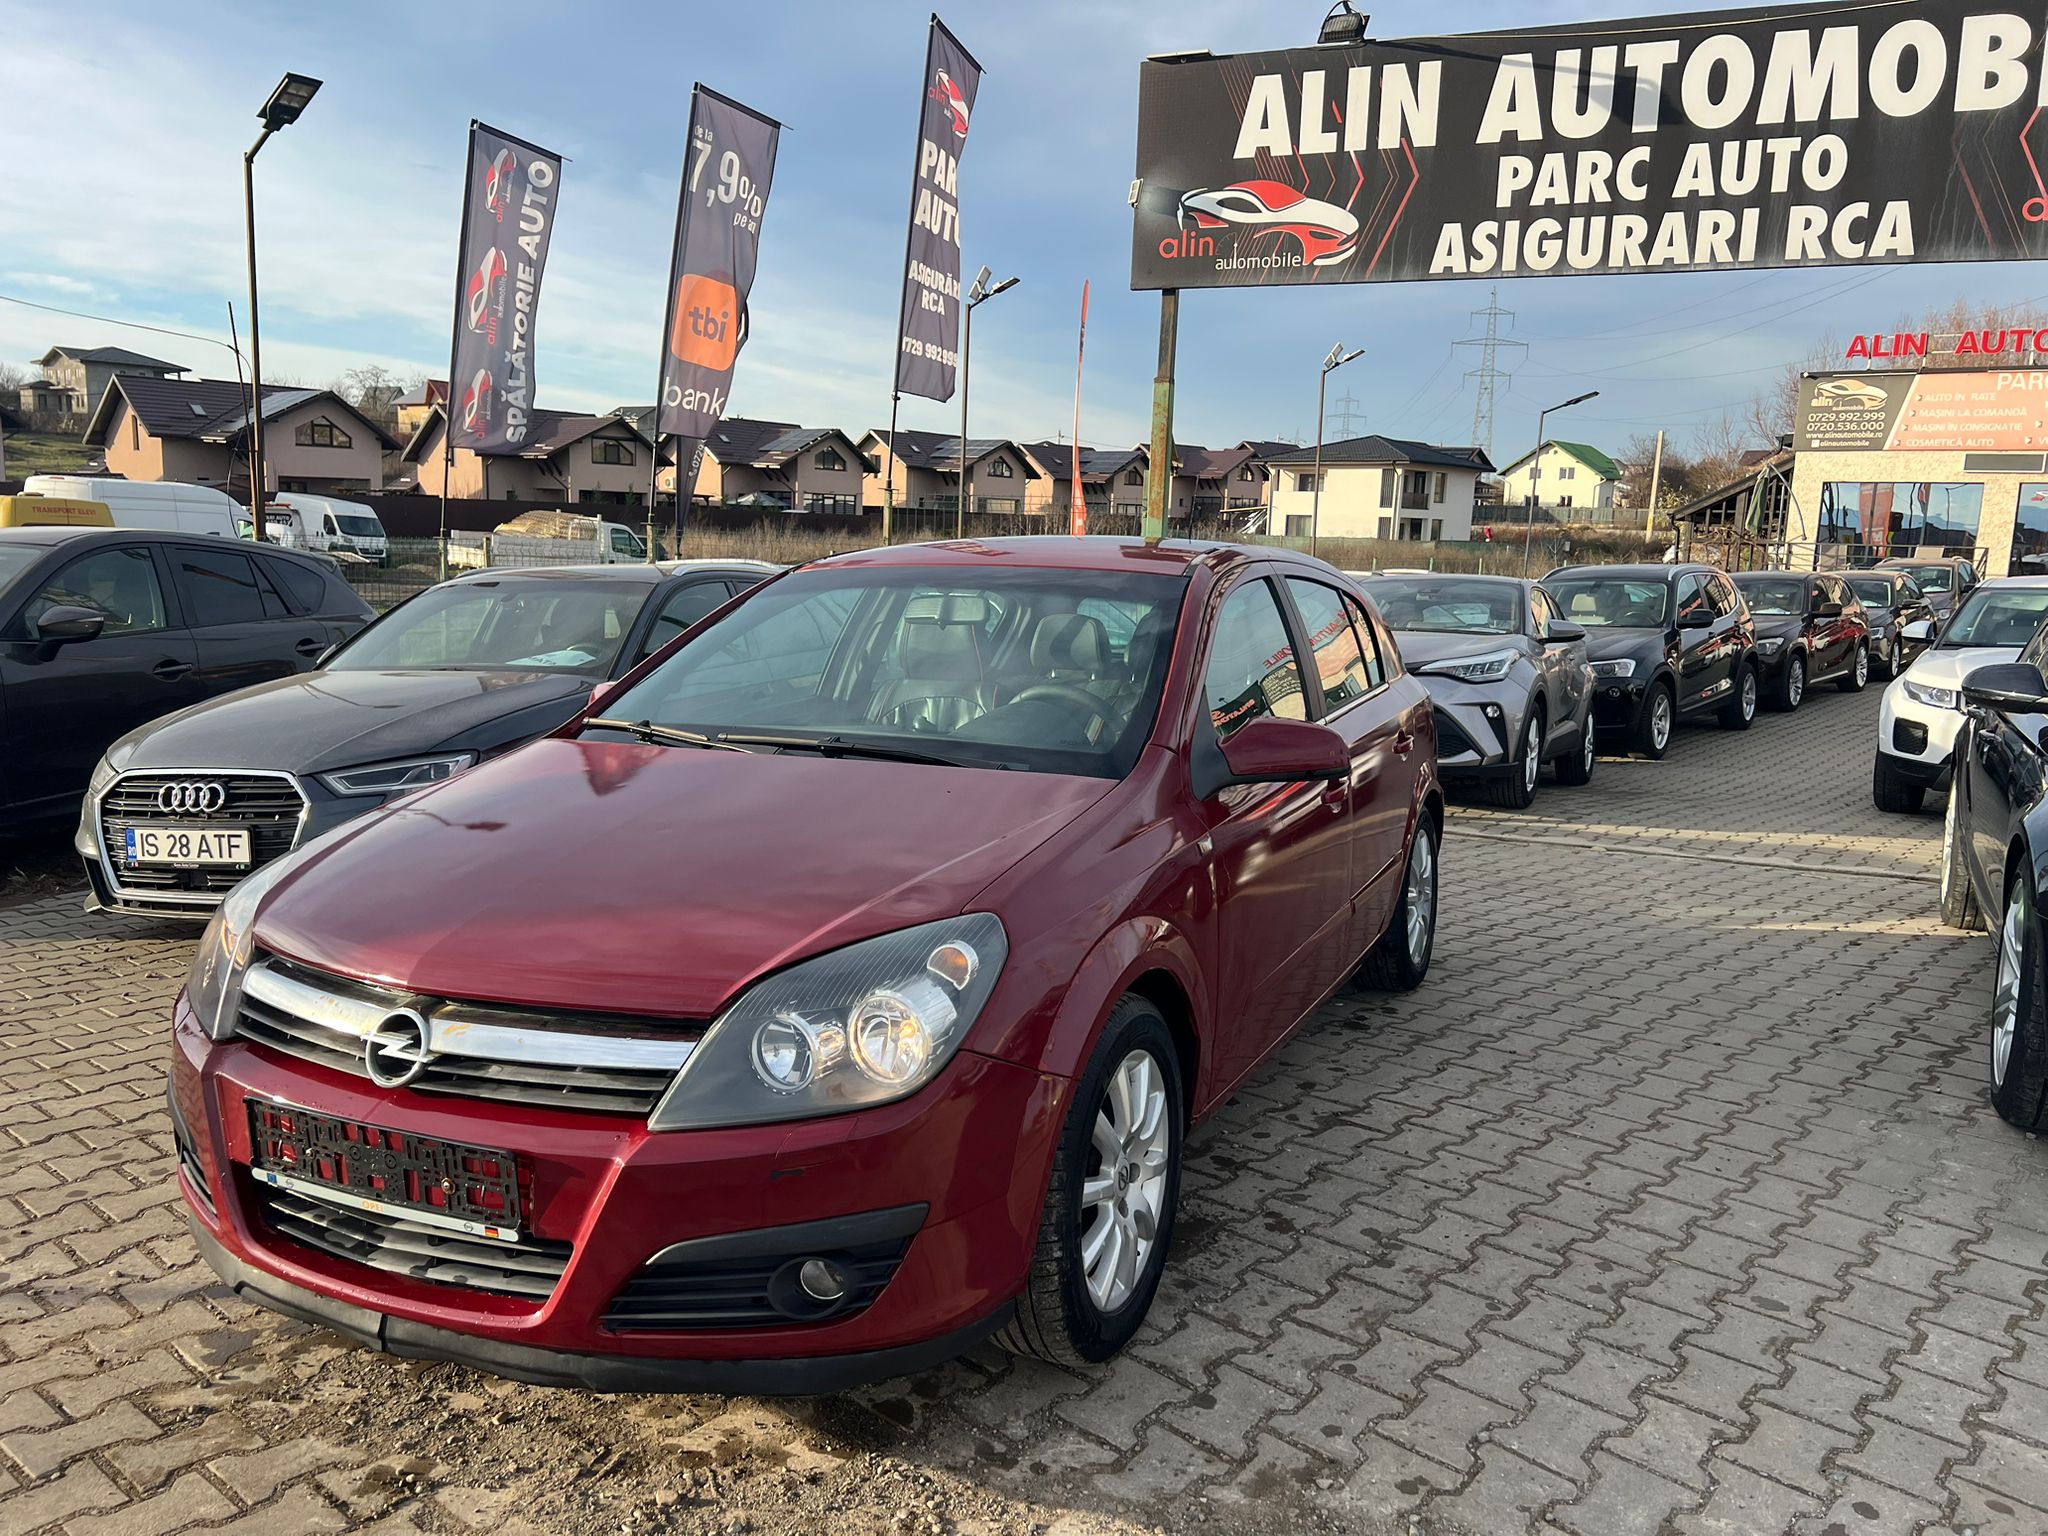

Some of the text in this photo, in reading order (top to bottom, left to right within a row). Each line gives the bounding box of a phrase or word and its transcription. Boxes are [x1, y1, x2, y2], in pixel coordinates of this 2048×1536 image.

[1233, 12, 2048, 159] ALIN AUTOMOB
[704, 128, 714, 142] la
[1495, 134, 1850, 208] PARC AUTO
[496, 199, 506, 224] alin
[732, 212, 748, 228] pe
[1158, 228, 1215, 259] alin
[1429, 201, 1917, 275] ASIGURARI RCA
[1215, 242, 1302, 271] automobile
[501, 160, 554, 443] SPĂLĂTORIE AUTO
[921, 288, 946, 316] RCA
[487, 315, 498, 345] alin
[688, 305, 730, 344] tbi
[1845, 331, 1928, 359] ALIN
[1997, 371, 2048, 392] PAR
[662, 375, 727, 419] bank
[1811, 396, 1833, 407] alin
[1923, 392, 1953, 401] AUTO
[1971, 392, 1998, 401] RATE
[1807, 411, 1886, 422] 0729.992.999
[1957, 408, 1972, 417] LA
[1806, 421, 1885, 432] 0720.536.000
[1965, 438, 1995, 447] AUTO
[140, 833, 242, 859] IS 28 ATF
